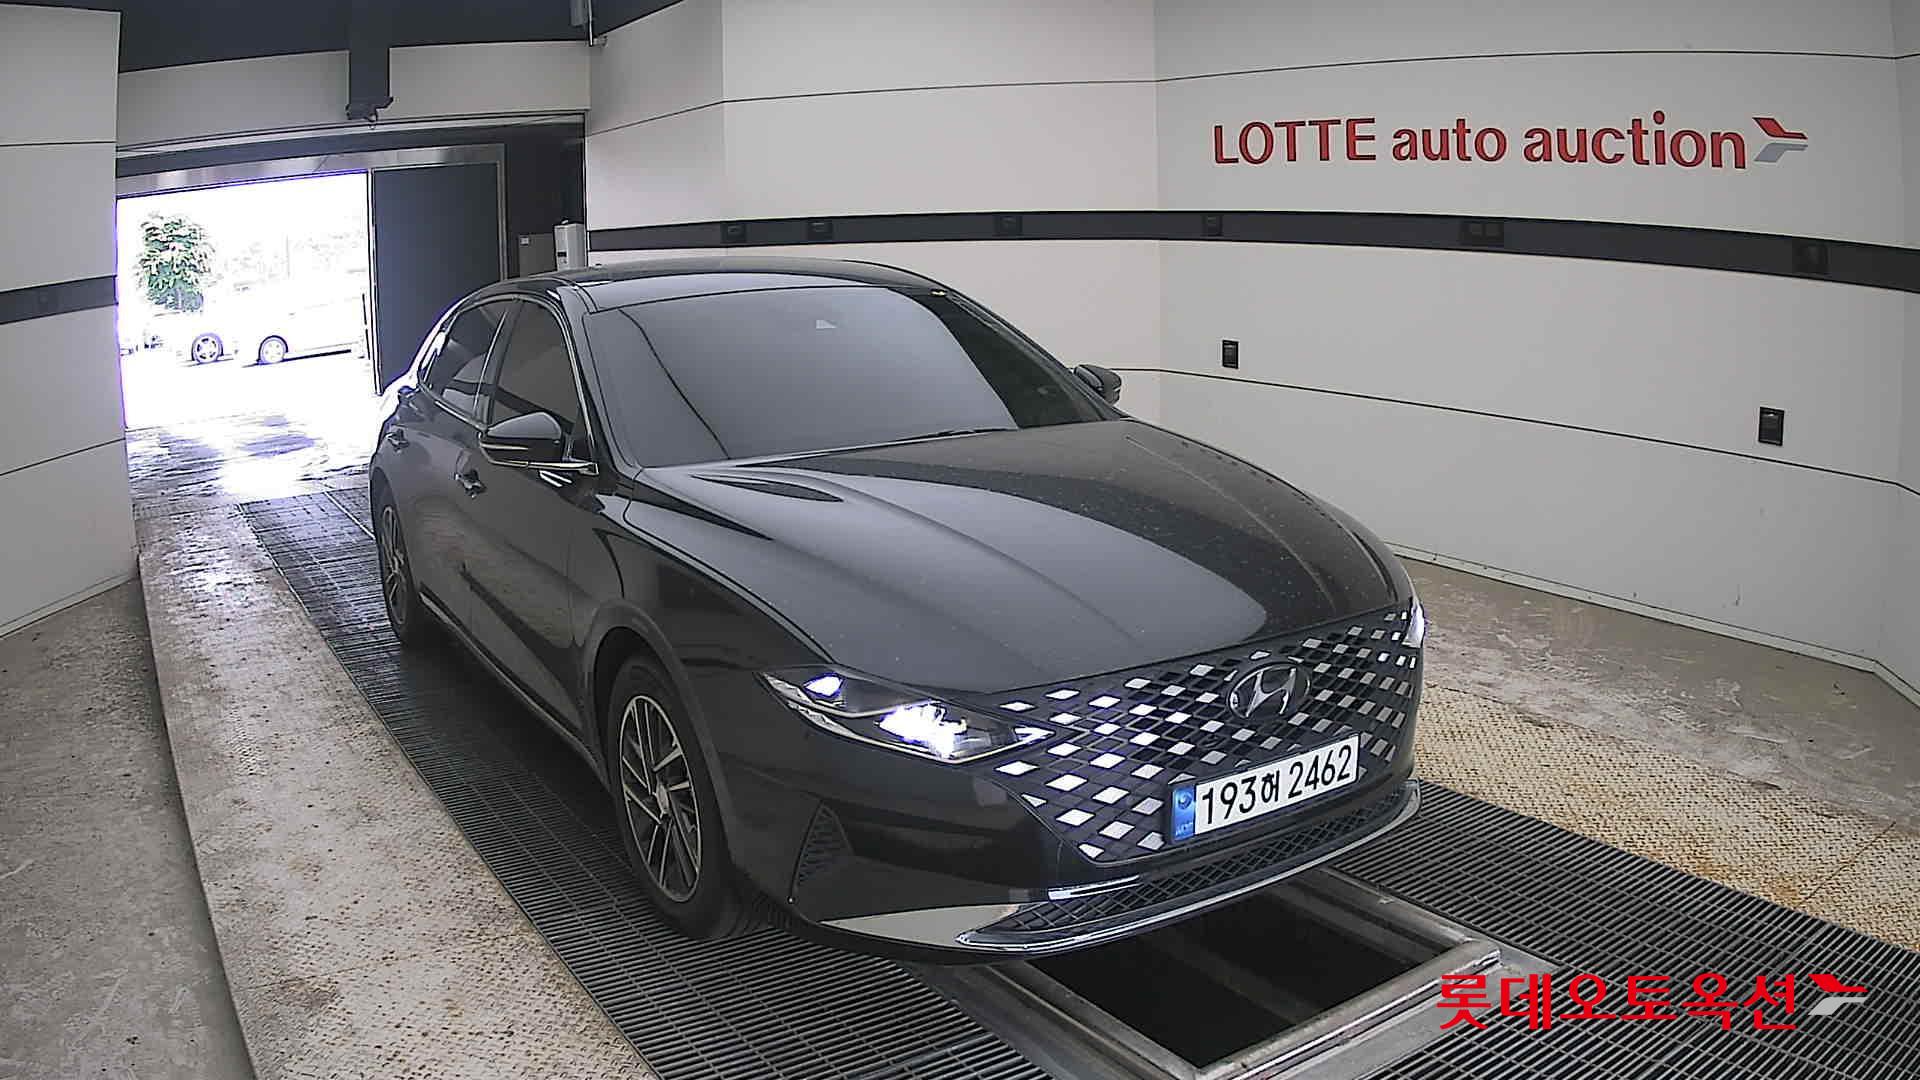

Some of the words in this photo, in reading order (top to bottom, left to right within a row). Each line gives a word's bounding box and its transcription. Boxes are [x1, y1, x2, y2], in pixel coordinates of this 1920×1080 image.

[1213, 117, 1376, 164] LOTTE
[1391, 118, 1508, 162] auto
[1522, 110, 1747, 169] auction
[1201, 768, 1280, 825] 193허
[1287, 744, 1352, 799] 2462
